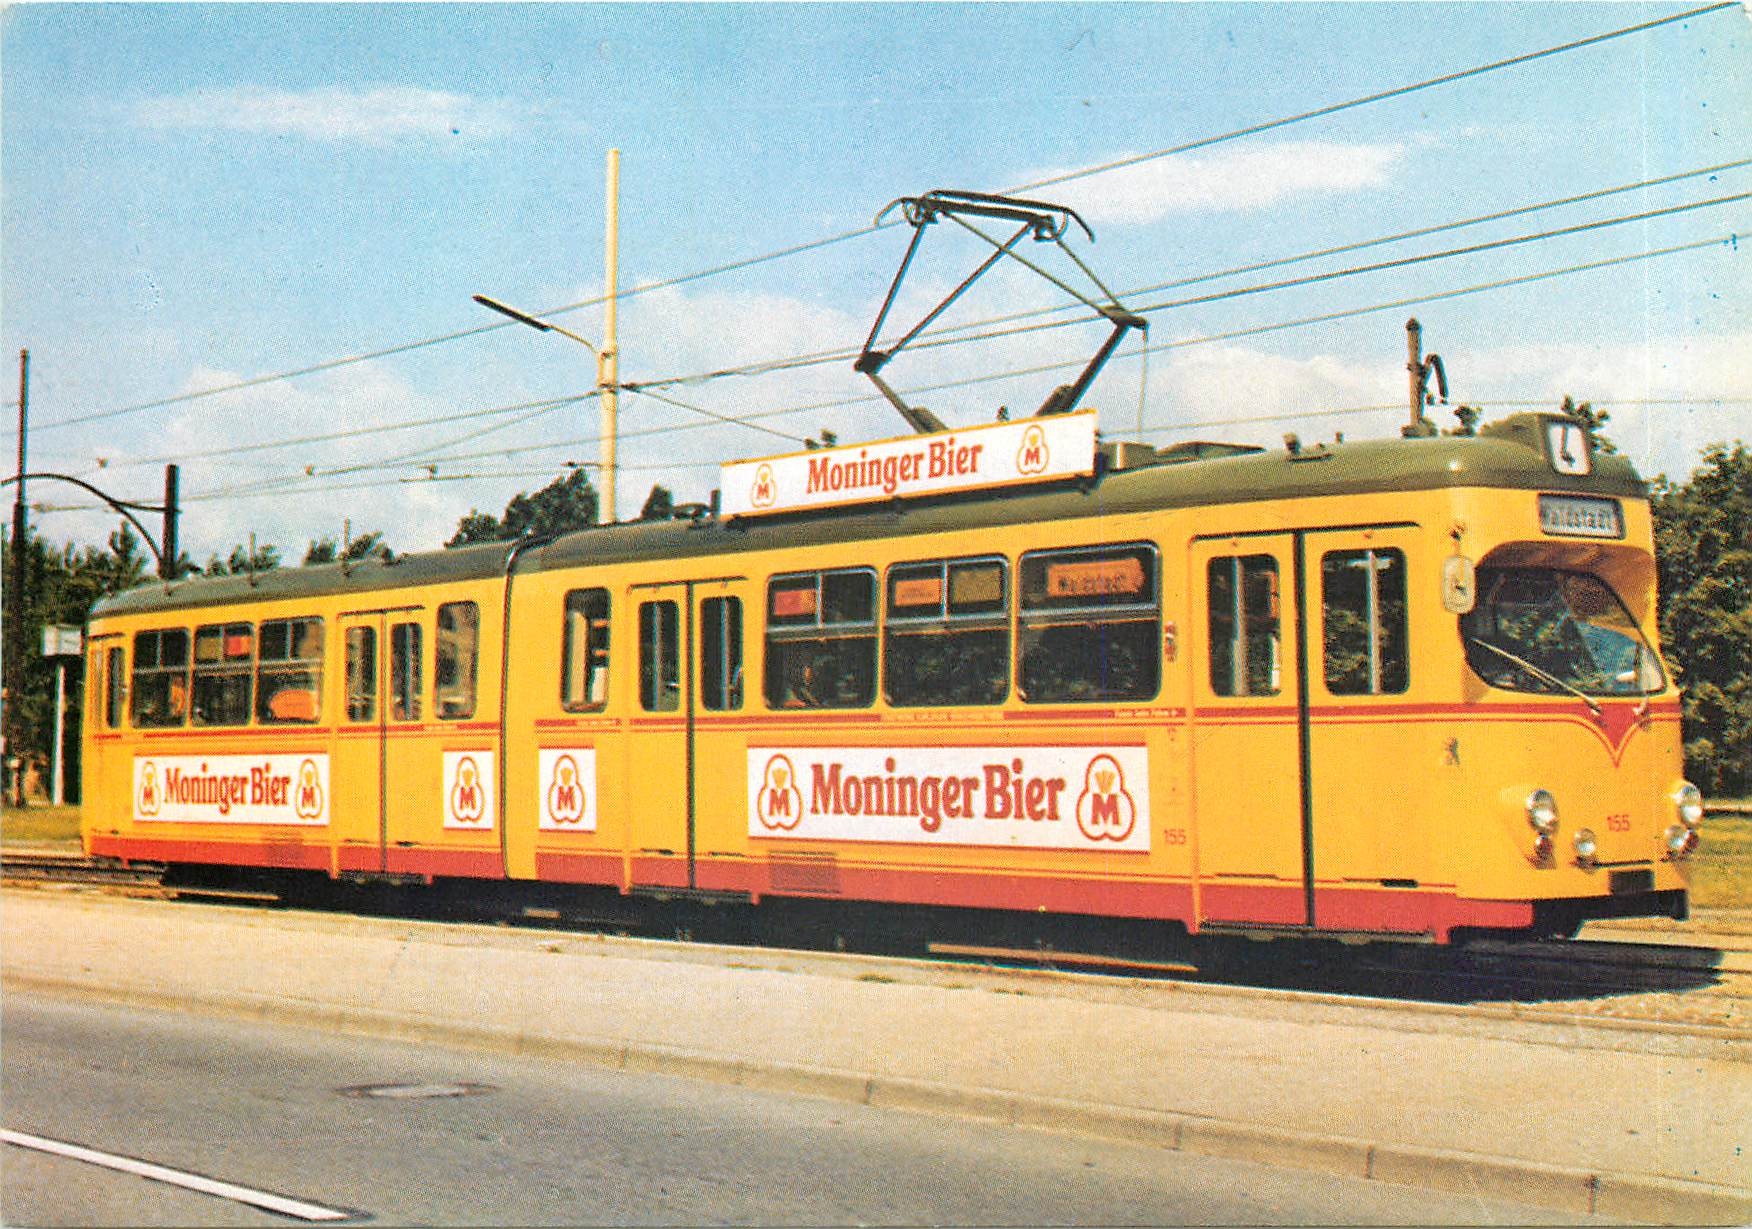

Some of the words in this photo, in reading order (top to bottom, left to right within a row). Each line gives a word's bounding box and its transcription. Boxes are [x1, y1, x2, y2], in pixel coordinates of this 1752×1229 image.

[755, 484, 770, 499] M
[806, 450, 924, 495] Moninger
[927, 437, 984, 479] Bier
[1024, 447, 1041, 466] M
[163, 762, 249, 816] Moninger
[250, 762, 291, 806] Bier
[301, 786, 316, 809] M
[459, 786, 477, 811] M
[557, 785, 575, 811] M
[768, 787, 791, 817] M
[810, 756, 980, 833] Moninger
[983, 757, 1067, 822] Bier
[1090, 792, 1121, 826] M
[1606, 813, 1631, 832] 155
[1163, 828, 1187, 845] 155
